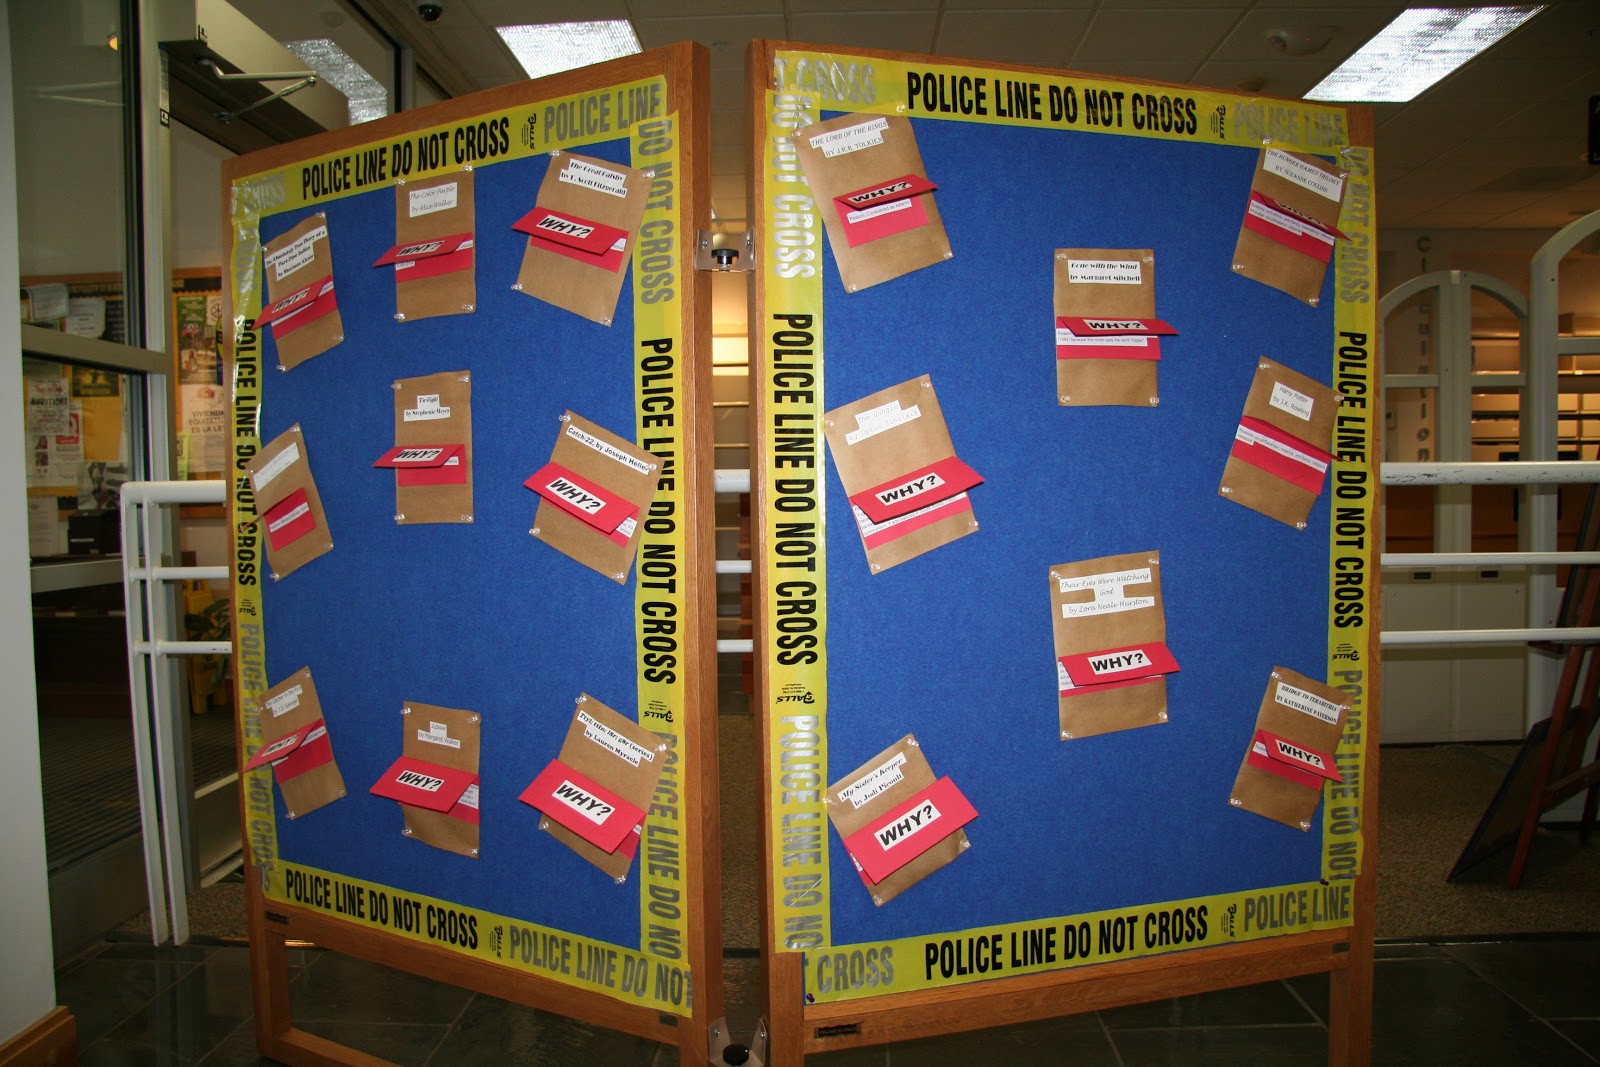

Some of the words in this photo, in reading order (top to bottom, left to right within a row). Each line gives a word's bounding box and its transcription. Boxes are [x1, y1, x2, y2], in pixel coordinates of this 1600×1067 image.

[796, 59, 875, 105] CROSS
[908, 72, 987, 116] POLICE
[994, 80, 1042, 120] LINE
[1049, 85, 1077, 124] DO
[1084, 88, 1124, 127] NOT
[1132, 93, 1197, 135] CROSS
[544, 94, 610, 144] POLICE
[812, 138, 825, 146] THE
[826, 133, 843, 142] LORD
[854, 127, 866, 136] THE
[867, 121, 887, 132] RINGS
[1235, 103, 1299, 144] POLICE
[638, 119, 673, 156] DO
[836, 144, 855, 153] J.R.R.
[856, 137, 883, 148] TOLKIEN
[303, 156, 350, 200] POLICE
[356, 147, 386, 186] LINE
[391, 141, 412, 177] DO
[417, 131, 449, 172] NOT
[454, 117, 509, 164] CROSS
[1267, 150, 1278, 158] THE
[1279, 154, 1299, 167] HUNGER
[1300, 164, 1318, 177] GAMES
[1318, 172, 1341, 186] TRILOGY
[421, 190, 435, 199] Color
[436, 186, 455, 196] Purple
[853, 182, 907, 202] WHY?
[1284, 169, 1308, 184] SUZANNE
[1308, 180, 1328, 193] COLLINS
[434, 199, 454, 208] Walker
[304, 234, 315, 247] Diary
[539, 217, 590, 237] WHY?
[773, 194, 816, 278] CROSS
[640, 220, 674, 304] CROSS
[1340, 232, 1370, 304] CROSS
[772, 314, 814, 404] POLICE
[1338, 332, 1367, 409] POLICE
[641, 338, 675, 428] POLICE
[1280, 386, 1293, 397] Harry
[1294, 392, 1308, 403] Potter
[861, 424, 882, 436] Upton
[885, 411, 918, 427] Sinclair
[874, 404, 898, 418] Jungle
[1290, 403, 1309, 416] Rowling
[397, 450, 440, 459] WHY?
[568, 427, 595, 447] Catch-22,
[595, 442, 603, 451] by
[605, 446, 627, 462] Joseph
[629, 458, 650, 472] Heller
[774, 414, 814, 468] LINE
[1337, 416, 1365, 463] LINE
[550, 479, 601, 510] WHY?
[774, 478, 816, 512] DO
[881, 475, 936, 502] WHY?
[1336, 470, 1367, 500] DO
[644, 502, 676, 534] DO
[1336, 508, 1365, 550] NOT
[237, 521, 257, 586] CROSS
[775, 522, 816, 572] NOT
[642, 544, 676, 594] NOT
[1082, 580, 1096, 588] Eyes
[1116, 574, 1150, 582] Watching
[1079, 605, 1096, 613] Zora
[1098, 602, 1118, 610] Neale
[1120, 598, 1148, 607] Hurston
[1100, 588, 1114, 596] God
[1334, 556, 1364, 628] CROSS
[776, 582, 818, 666] CROSS
[641, 602, 678, 684] CROSS
[1092, 653, 1143, 672] WHY?
[1281, 685, 1300, 695] BRIDGE
[1309, 695, 1337, 712] TERABITHIA
[1284, 698, 1313, 712] KATHERINE
[1313, 709, 1337, 724] PATERSON
[425, 733, 443, 742] Margaret
[444, 738, 459, 746] Walker
[594, 734, 614, 750] Lauren
[615, 748, 639, 765] Myracle
[629, 742, 653, 760] (series)
[1279, 742, 1321, 765] WHY?
[780, 715, 820, 805] POLICE
[399, 772, 441, 789] WHY?
[841, 788, 854, 800] My
[854, 773, 878, 790] Sister's
[879, 759, 902, 777] Keeper
[854, 799, 862, 807] by
[863, 788, 878, 802] Jodi
[878, 774, 902, 791] Picoult
[557, 784, 611, 816] WHY?
[879, 805, 933, 846] WHY?
[1330, 807, 1360, 835] DO
[648, 825, 680, 880] LINE
[782, 812, 821, 867] LINE
[648, 885, 680, 920] DO
[783, 874, 823, 908] DO
[286, 868, 331, 909] POLICE
[336, 881, 365, 918] LINE
[369, 890, 389, 925] DO
[393, 896, 421, 934] NOT
[427, 905, 478, 949] CROSS
[1244, 889, 1307, 932] POLICE
[1312, 885, 1350, 921] LINE
[817, 946, 894, 993] CROSS
[925, 934, 1003, 980] POLICE
[1011, 927, 1056, 968] LINE
[1064, 921, 1091, 960] DO
[1099, 915, 1138, 955] NOT
[1144, 905, 1208, 949] CROSS
[510, 925, 571, 975] POLICE
[577, 942, 617, 988] LINE
[621, 954, 648, 997] DO
[655, 963, 692, 1008] NOT
